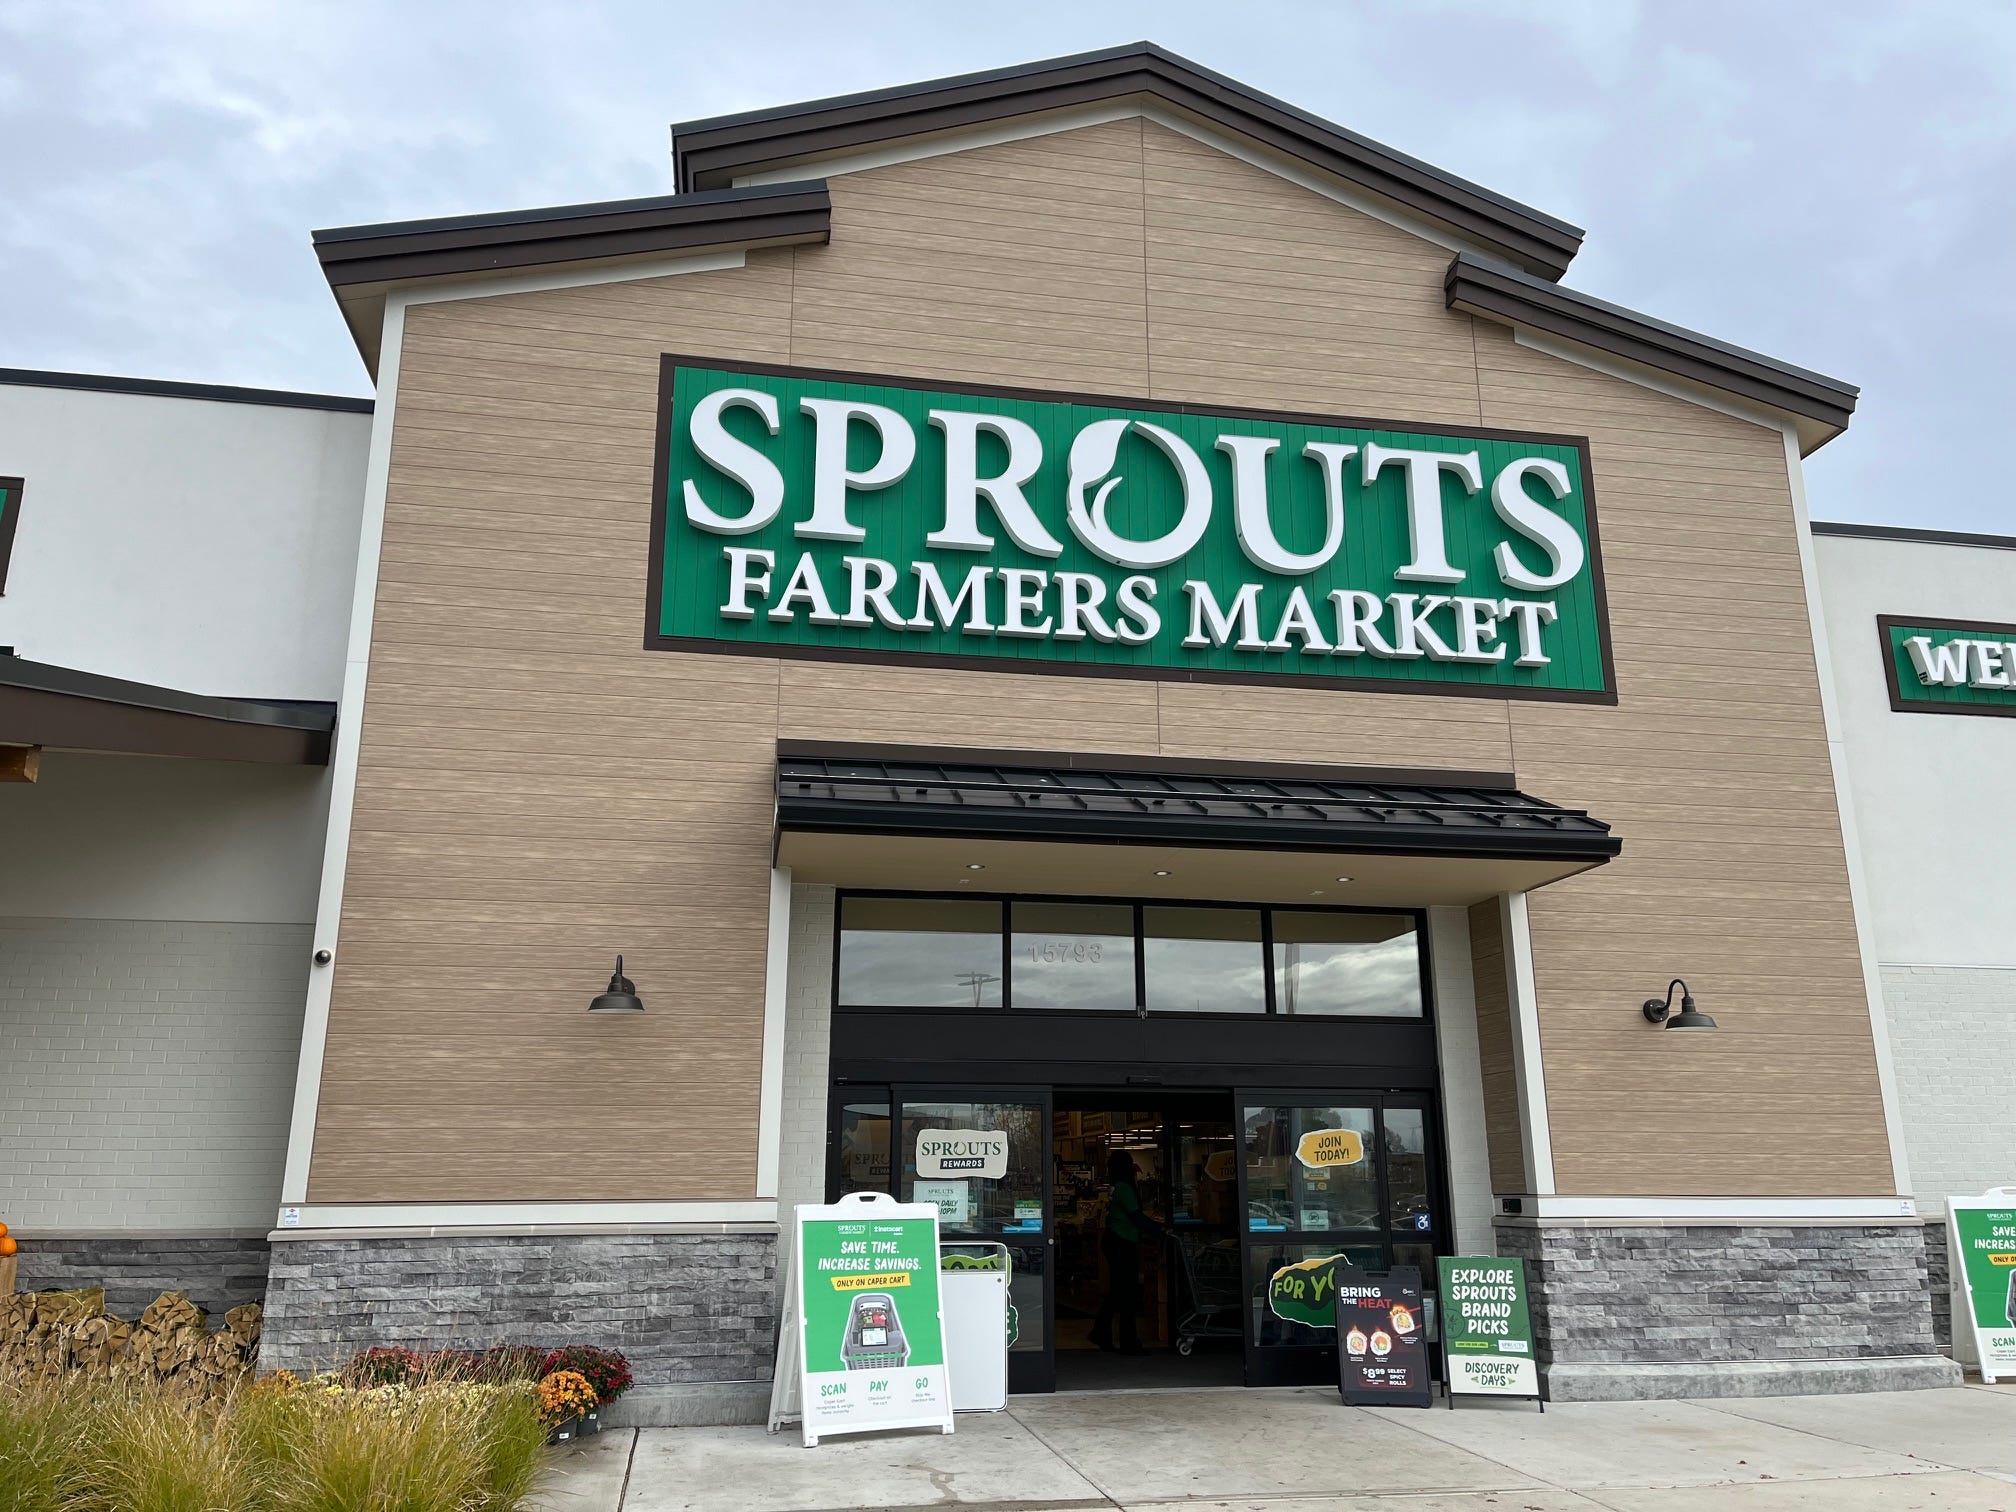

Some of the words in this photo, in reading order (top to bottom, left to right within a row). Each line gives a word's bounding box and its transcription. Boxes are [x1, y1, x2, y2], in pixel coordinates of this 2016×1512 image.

[683, 388, 1583, 591] SPROUTS
[720, 546, 1161, 645] FARMERS
[1181, 580, 1557, 668] MARKET
[1028, 943, 1103, 963] 15793
[921, 1141, 1001, 1156] SPROUTS
[1319, 1136, 1342, 1149] JOIN
[1314, 1148, 1350, 1162] TODAY!
[942, 1159, 983, 1168] REWARDS
[941, 1199, 959, 1207] DAILY
[1992, 1226, 2016, 1237] SAVE
[840, 1241, 867, 1254] SAVE
[871, 1241, 900, 1254] TIME.
[818, 1257, 871, 1271] INCREASE
[874, 1257, 922, 1271] SAVINGS.
[836, 1279, 854, 1288] ONLY
[855, 1278, 866, 1287] ON
[867, 1277, 888, 1286] CAPER
[889, 1275, 905, 1284] CART
[1451, 1269, 1514, 1284] EXPLORE
[1274, 1275, 1305, 1299] FOR
[1340, 1287, 1381, 1298] BRING
[1452, 1285, 1517, 1302] SPROUTS
[1358, 1298, 1392, 1309] HEAT
[1461, 1302, 1511, 1318] BRAND
[1468, 1319, 1509, 1335] PICKS
[1992, 1336, 2016, 1347] SCAN
[1465, 1362, 1520, 1375] DISCOVERY
[869, 1380, 889, 1393] PAY
[915, 1377, 929, 1390] GO
[1481, 1375, 1506, 1386] DAYS
[821, 1382, 847, 1397] SCAN
